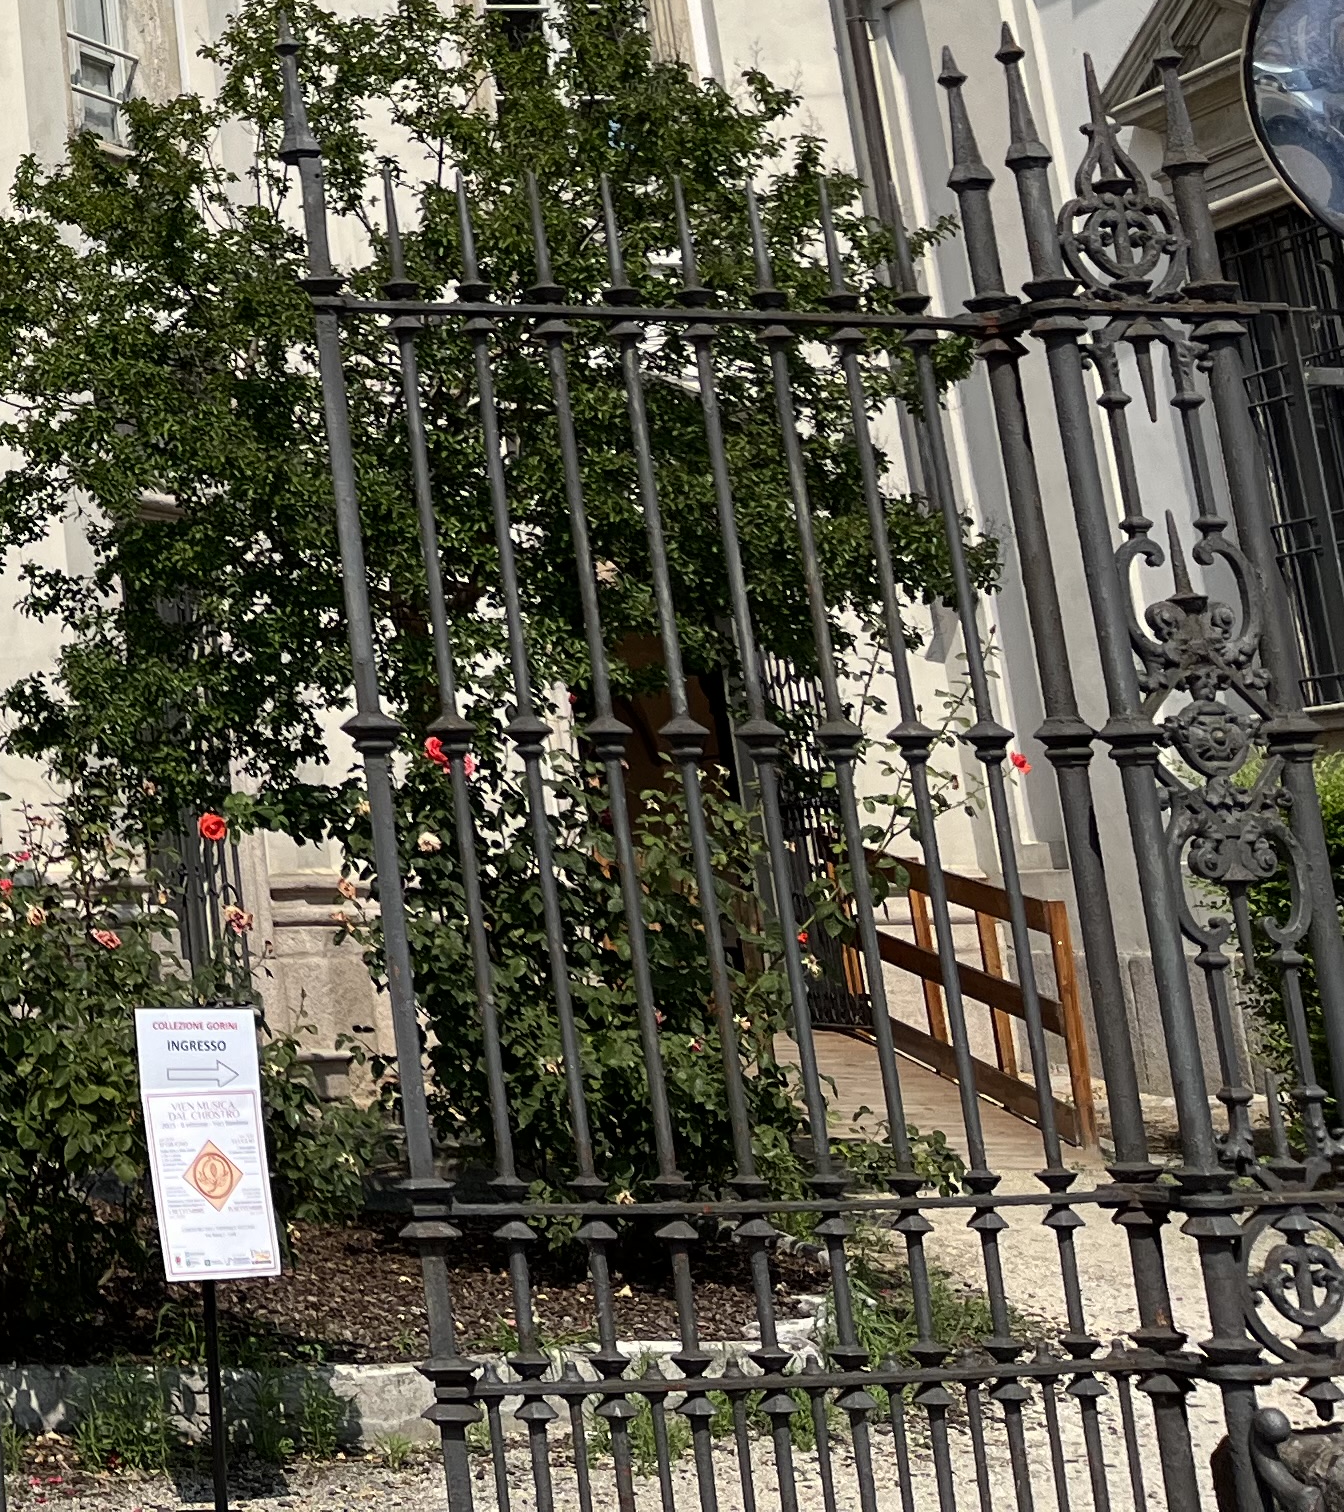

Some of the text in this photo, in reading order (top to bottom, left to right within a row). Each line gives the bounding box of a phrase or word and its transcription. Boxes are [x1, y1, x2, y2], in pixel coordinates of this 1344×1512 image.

[152, 1021, 238, 1030] COLLEZIONE GORINI
[167, 1040, 227, 1051] INGRESSO
